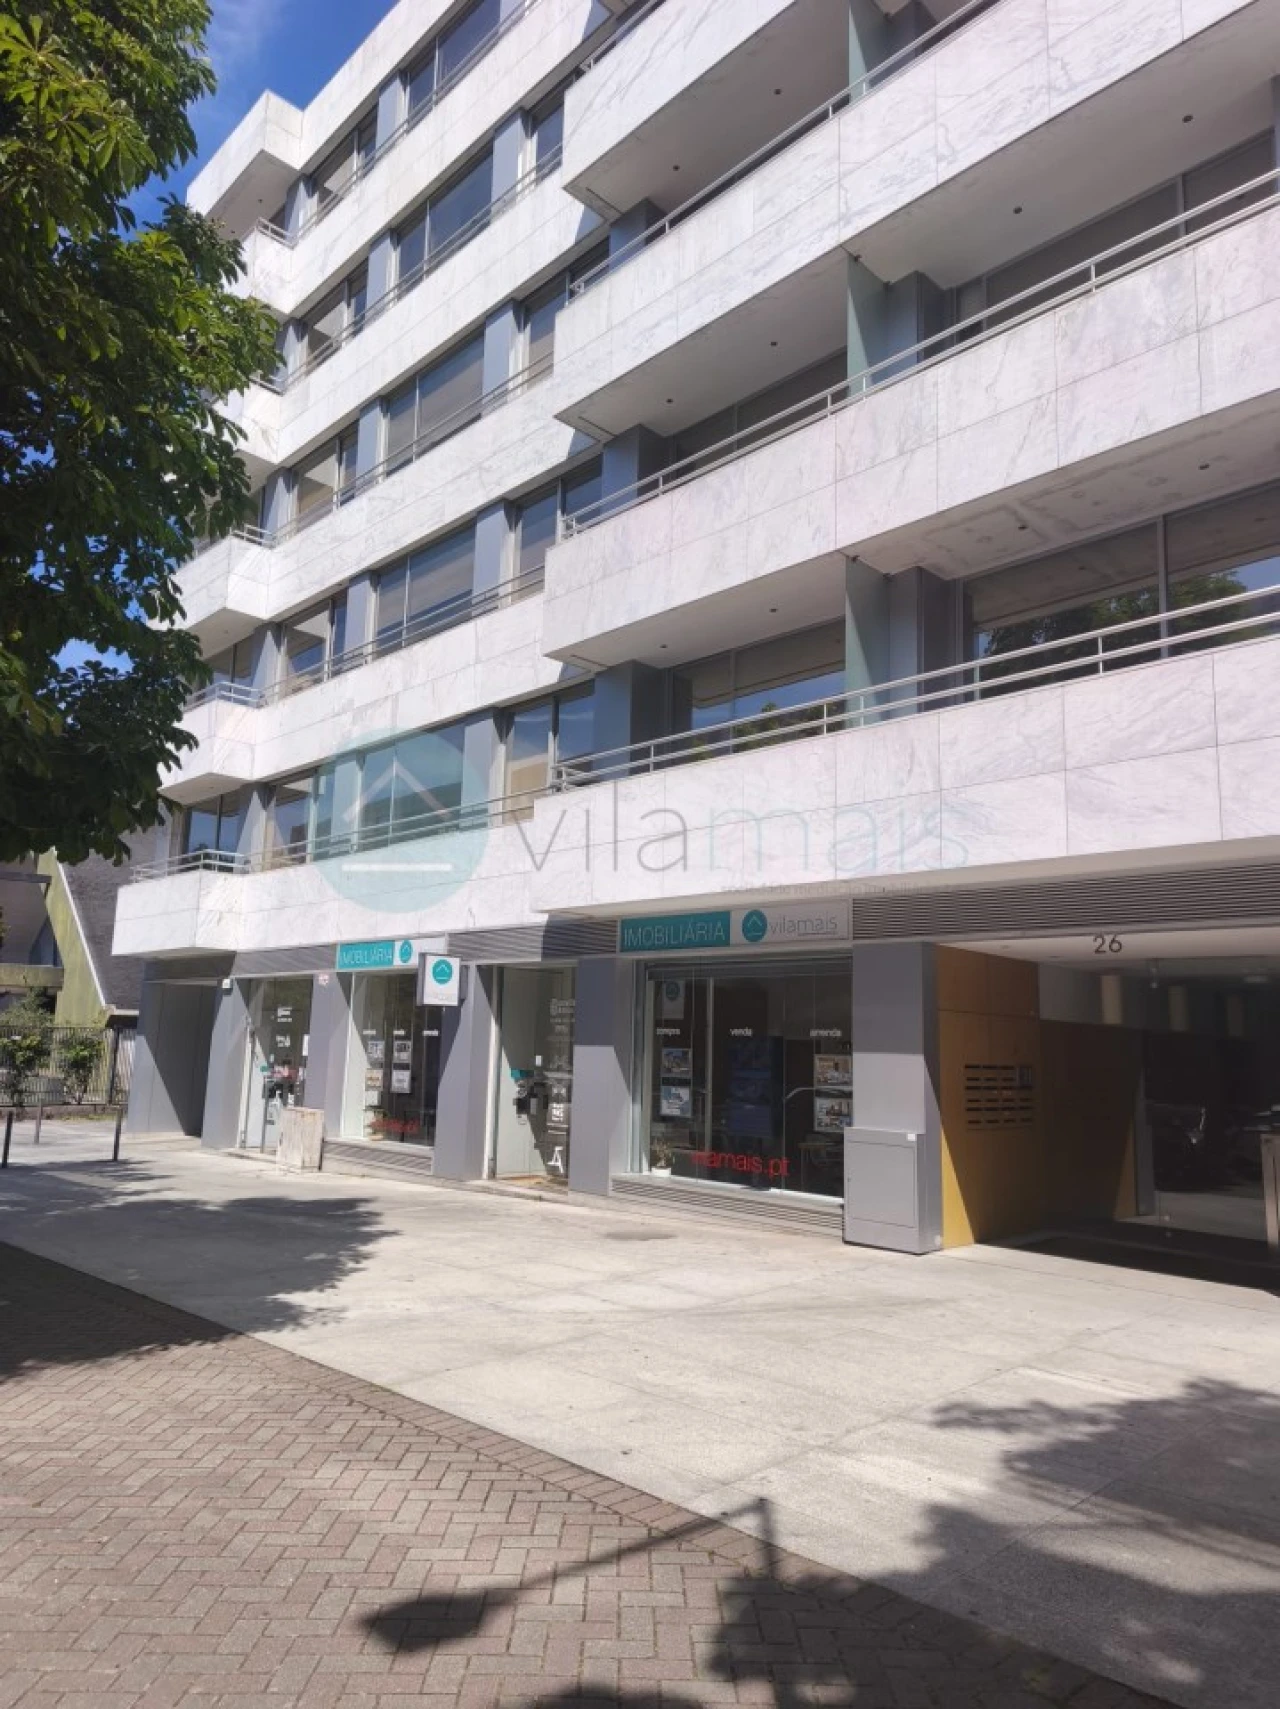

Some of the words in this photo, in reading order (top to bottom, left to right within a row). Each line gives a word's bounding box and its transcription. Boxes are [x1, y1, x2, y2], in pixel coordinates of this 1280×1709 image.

[623, 919, 726, 947] IMOBILIÁRIA
[769, 912, 838, 935] vilamais
[1093, 932, 1122, 954] 26
[730, 1027, 753, 1037] venda
[692, 1151, 788, 1178] amais.pt
